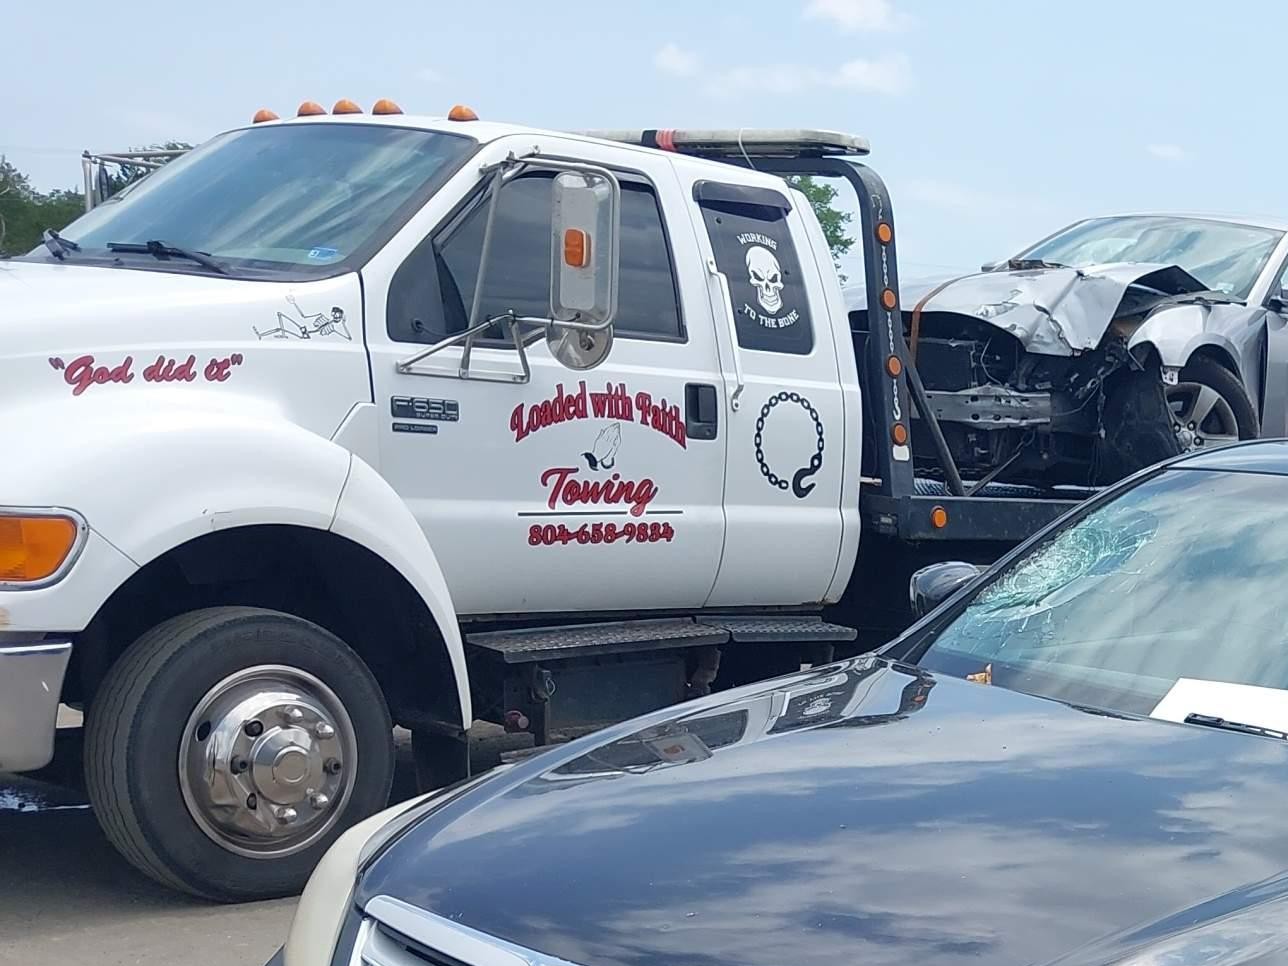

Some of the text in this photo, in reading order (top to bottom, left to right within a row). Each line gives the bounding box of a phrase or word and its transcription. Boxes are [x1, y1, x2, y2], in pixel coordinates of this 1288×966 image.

[737, 232, 777, 250] WORKING
[744, 303, 799, 328] TO THE BONE
[49, 353, 243, 396] "God did it"
[510, 380, 687, 449] Loaded with Faith
[541, 467, 658, 517] Towing
[528, 522, 674, 545] 804-658-9834
